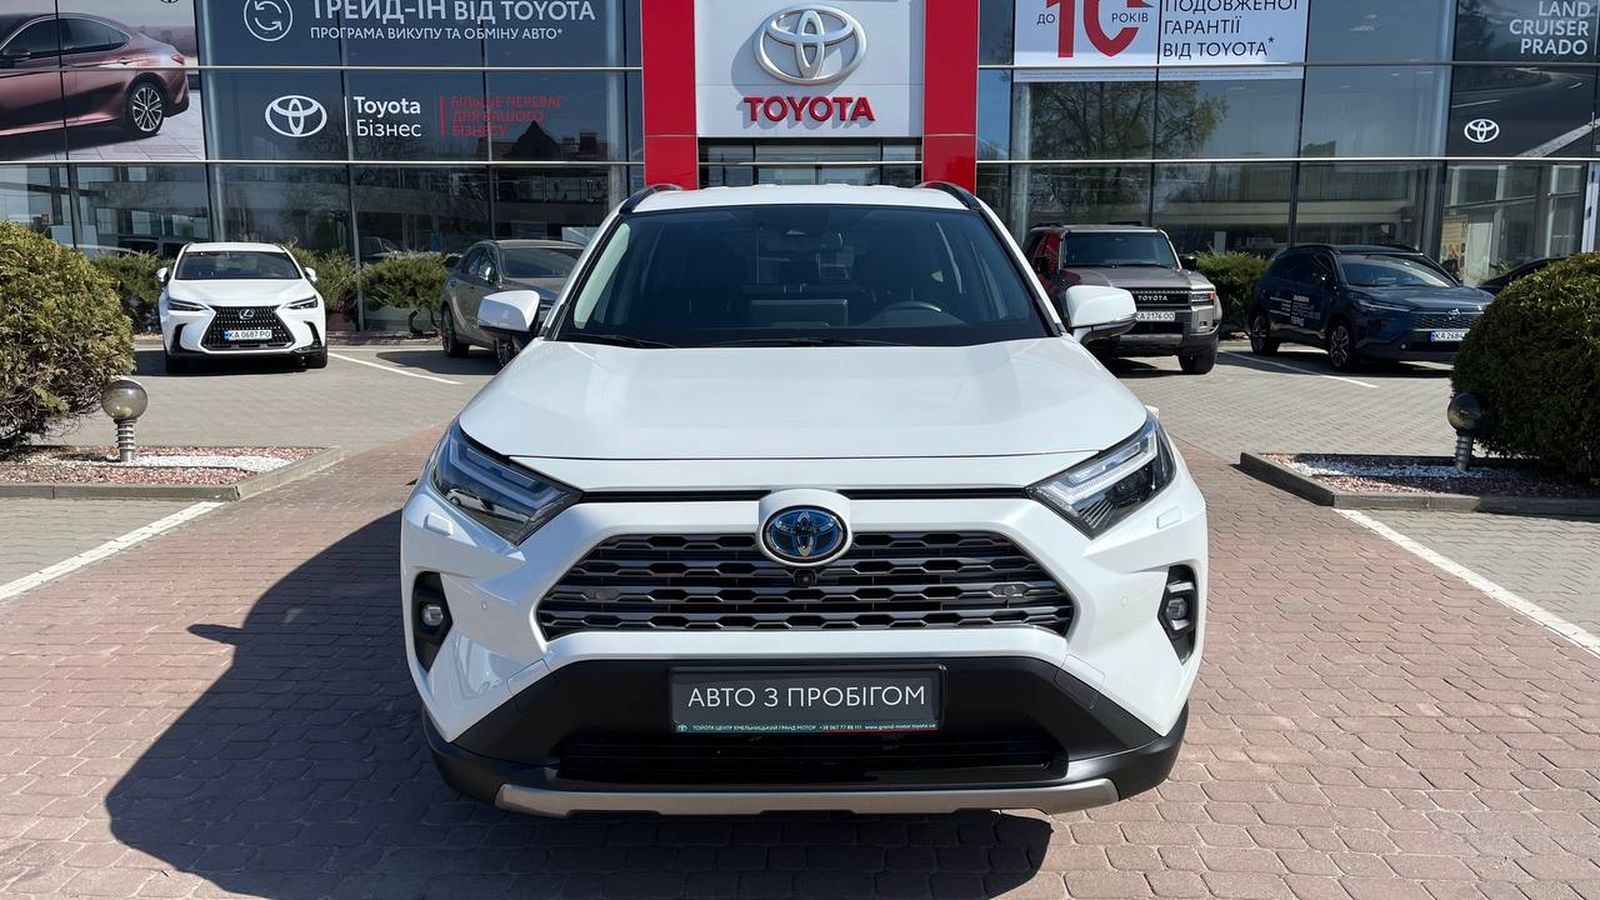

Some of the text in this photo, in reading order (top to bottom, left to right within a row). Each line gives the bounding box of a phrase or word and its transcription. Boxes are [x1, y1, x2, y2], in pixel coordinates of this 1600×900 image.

[454, 1, 496, 24] ВІД
[1538, 1, 1591, 17] LAND
[1037, 14, 1056, 24] ДО
[1111, 13, 1149, 23] РОКІВ
[1164, 16, 1242, 34] ГАРАНТІЇ
[310, 27, 384, 39] ПРОГРАМА
[388, 27, 442, 39] ВИКУПУ
[445, 28, 461, 39] ТА
[464, 28, 519, 39] ОБМІНУ
[1509, 19, 1589, 36] CRUISER
[1163, 43, 1192, 60] ВІД
[1520, 38, 1588, 55] PRADO
[353, 96, 421, 118] Toyota
[743, 97, 876, 122] TOYOTA
[356, 120, 422, 137] Бізнес
[688, 687, 756, 708] АВТО
[787, 685, 926, 708] ПРОБІГОМ
